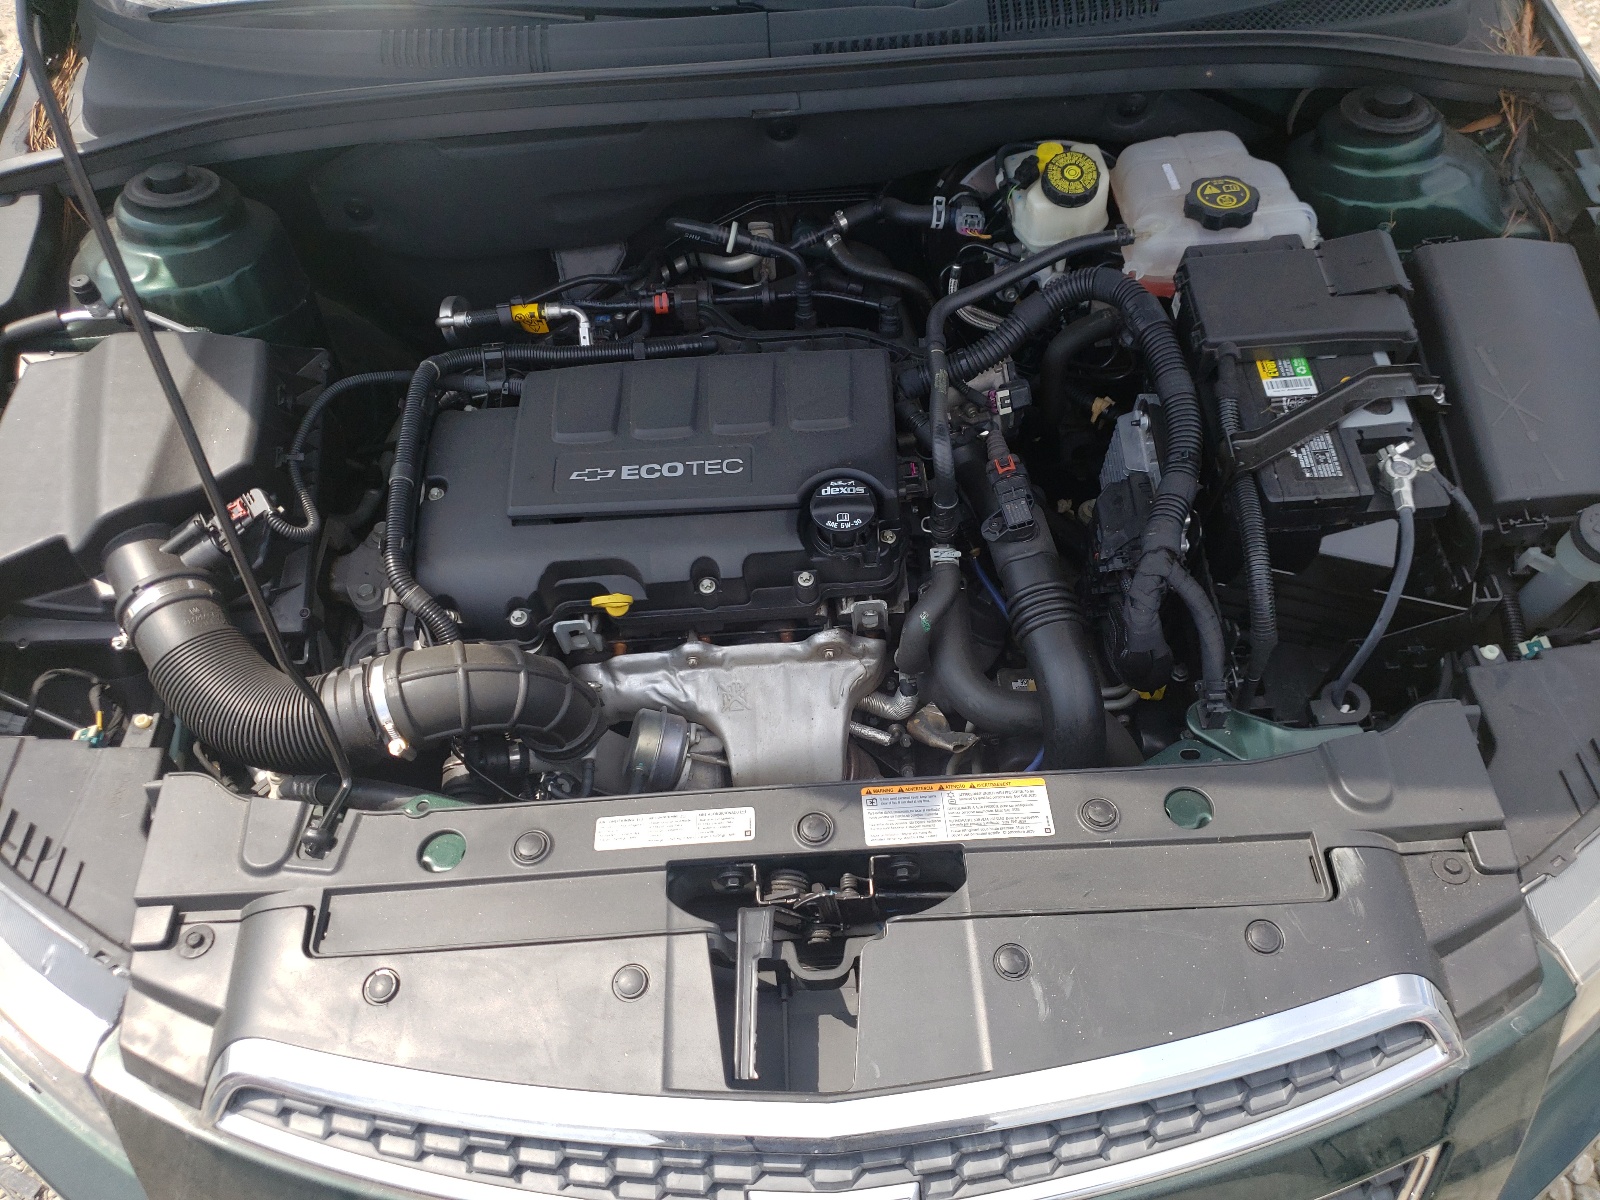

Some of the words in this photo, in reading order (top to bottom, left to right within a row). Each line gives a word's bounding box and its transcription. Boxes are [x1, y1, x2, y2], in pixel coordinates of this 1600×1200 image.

[620, 458, 744, 480] ECOTEC
[821, 486, 867, 496] dexos
[826, 520, 839, 529] SAE
